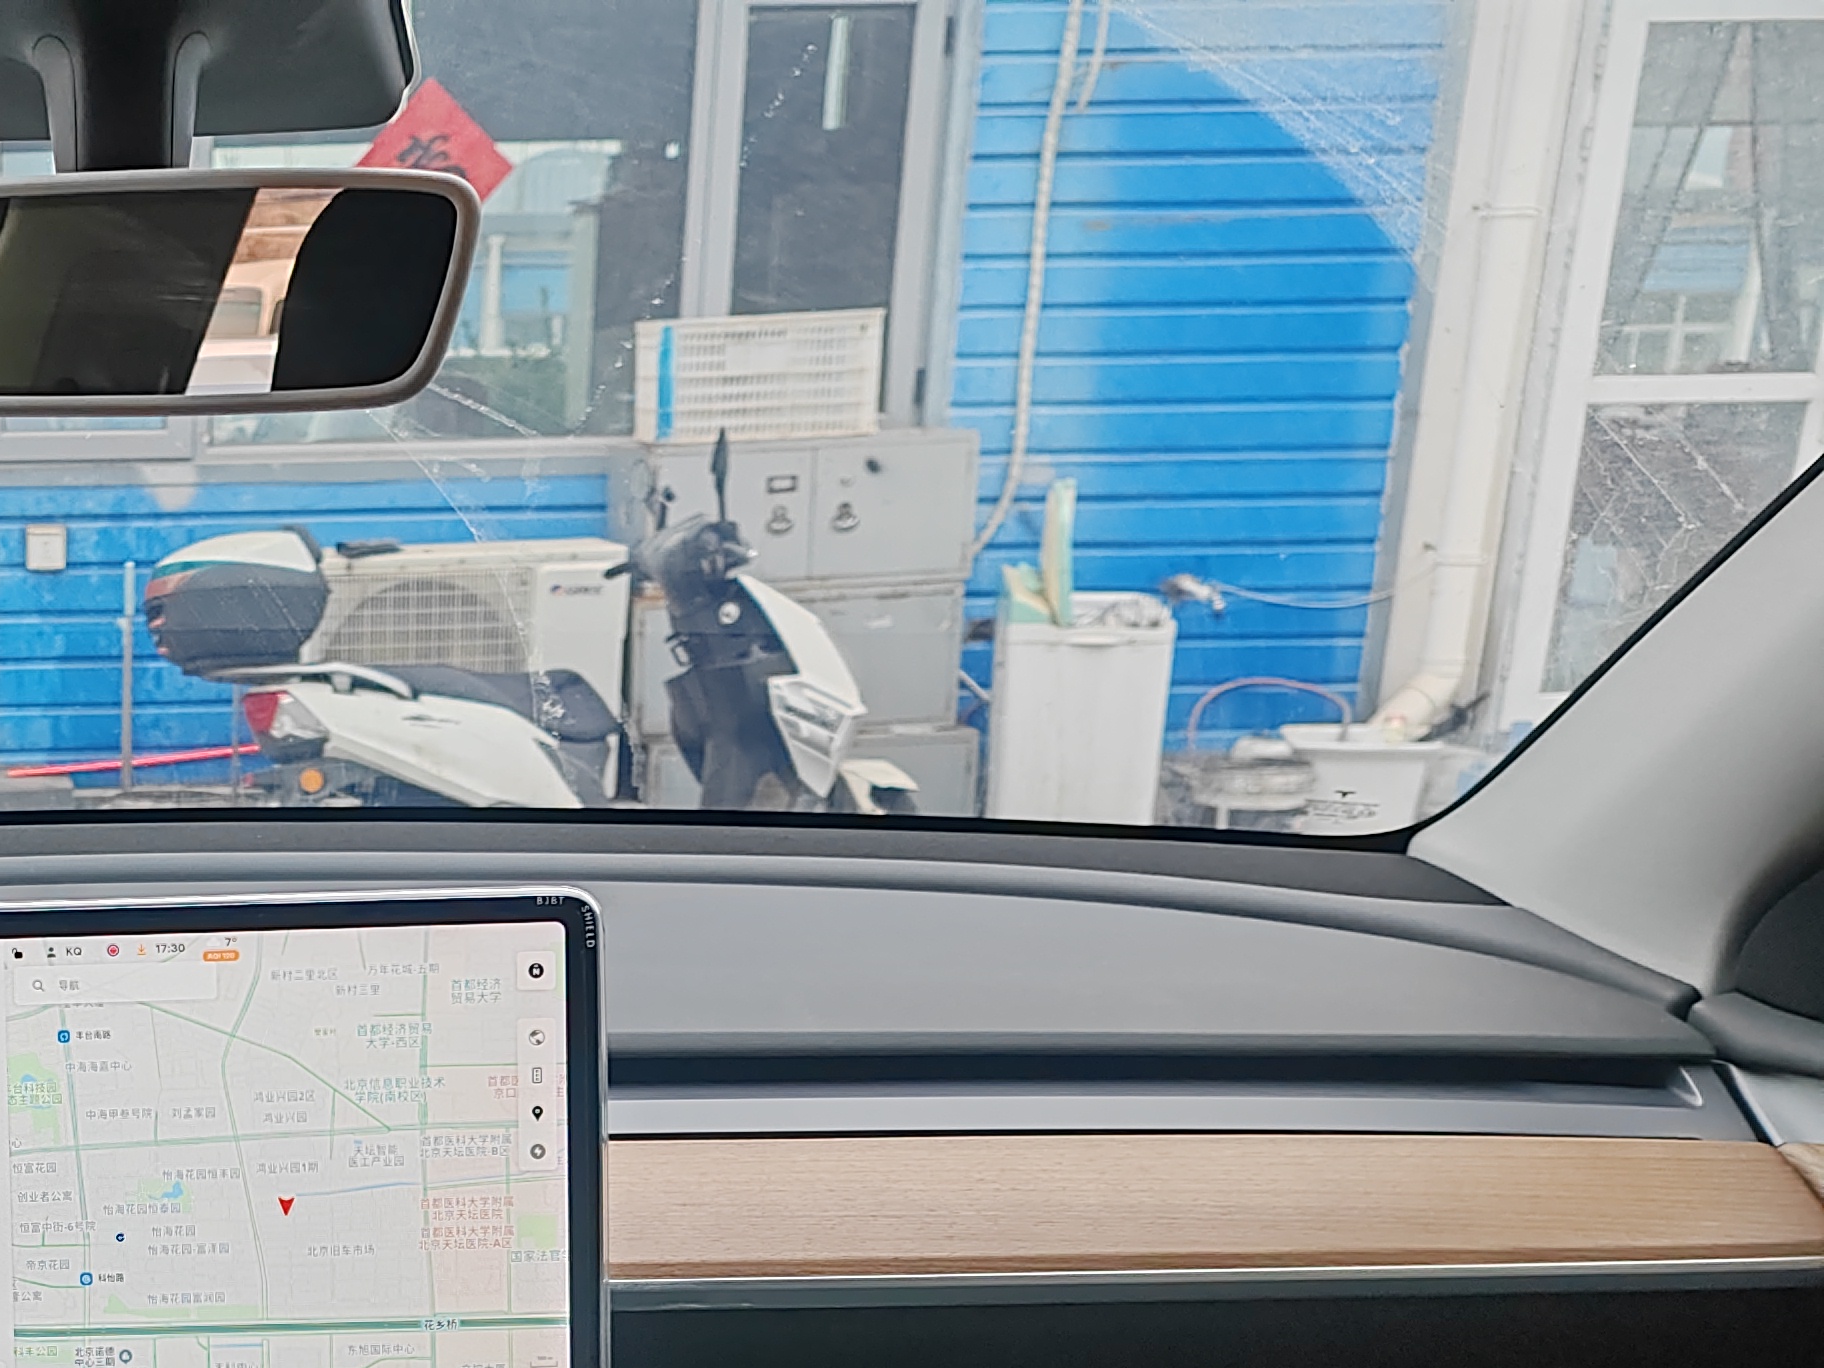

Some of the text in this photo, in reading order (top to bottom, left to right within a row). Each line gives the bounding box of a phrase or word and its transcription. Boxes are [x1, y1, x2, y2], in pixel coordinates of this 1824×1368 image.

[536, 896, 565, 905] BJBT
[581, 905, 596, 948] SHIELD
[66, 947, 82, 957] KQ
[155, 943, 186, 954] 17:30
[59, 980, 80, 992] 导航
[451, 978, 502, 992] 首都经济
[451, 991, 502, 1004] 贸易大学
[357, 1023, 433, 1037] 首都经济贸易
[344, 1077, 446, 1091] 北京信息职业技术
[421, 1133, 512, 1146] 首都医科大学附属
[12, 1163, 57, 1174] 恒富花园
[17, 1191, 73, 1203] 创业者公寓
[421, 1195, 514, 1209] 首都医科大学附属
[432, 1209, 503, 1221] 北京天坛医院
[151, 1225, 196, 1237] 怡海花园
[421, 1225, 515, 1239] 首都医科大学附属
[307, 1245, 375, 1257] 北京旧车市场
[26, 1259, 70, 1271] 帝京花园
[424, 1319, 459, 1331] 花乡桥
